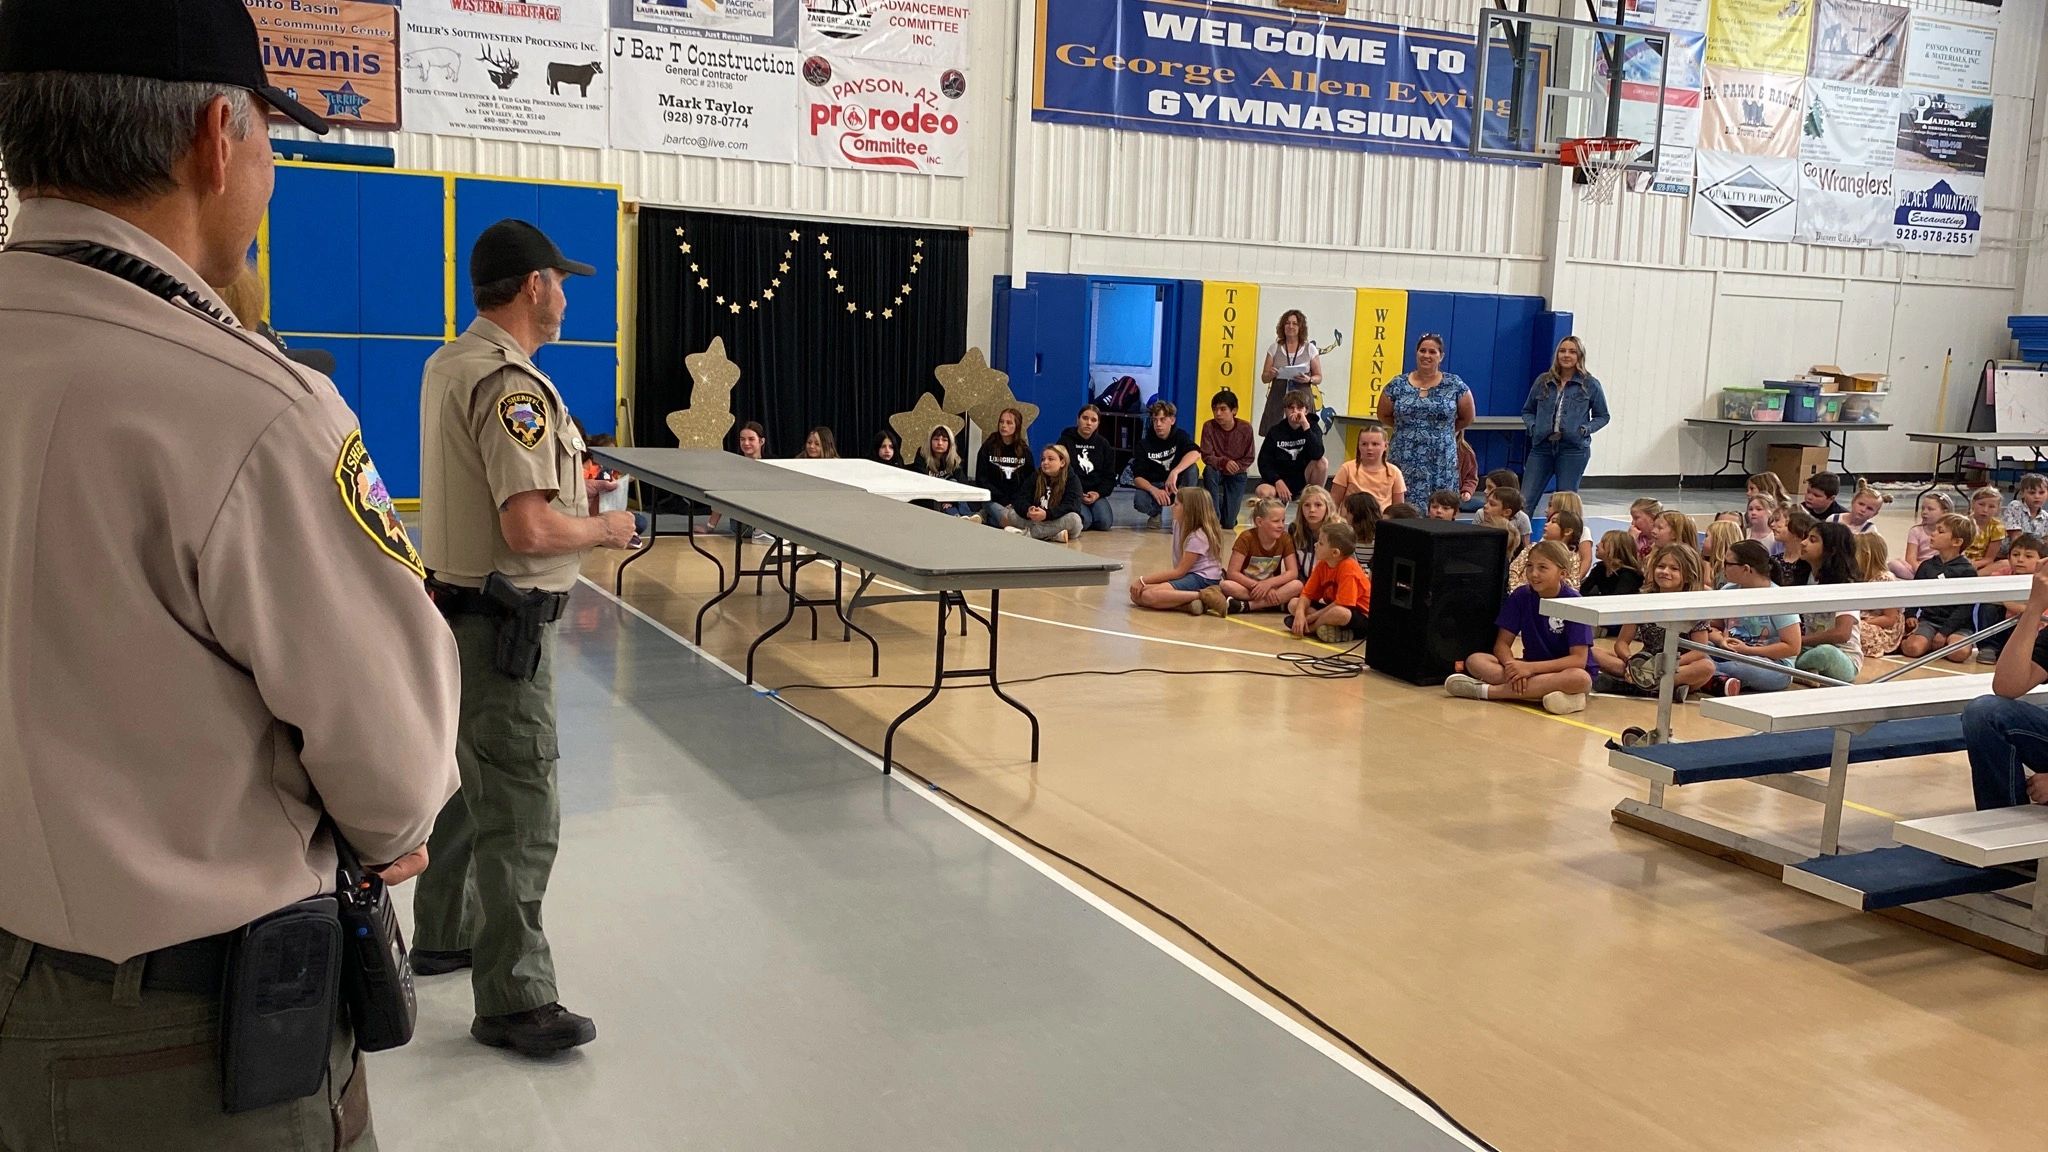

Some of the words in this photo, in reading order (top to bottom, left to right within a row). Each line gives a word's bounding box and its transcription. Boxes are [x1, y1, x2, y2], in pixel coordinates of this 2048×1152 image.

[245, 0, 283, 10] onto
[291, 0, 338, 15] Basin
[451, 0, 503, 14] WESTERN
[507, 2, 560, 20] HERITAGE
[725, 8, 767, 18] MORTGAGE
[880, 0, 969, 19] ADVANCEMENT
[260, 17, 268, 25] &
[274, 18, 346, 34] Community
[351, 25, 392, 37] Center
[807, 14, 825, 22] ZANE
[889, 16, 959, 34] COMMITTEE
[283, 35, 309, 45] Since
[406, 23, 449, 36] MILLER'S
[452, 28, 522, 44] SOUTHWESTERN
[525, 36, 578, 50] PROCESSING
[581, 41, 598, 52] INC.
[657, 25, 668, 33] No
[704, 30, 720, 39] Just
[722, 32, 753, 42] Results!
[912, 34, 936, 47] INC.
[1142, 10, 1387, 66] WELCOME
[1410, 44, 1467, 75] TO
[262, 37, 381, 75] iwanis
[613, 37, 625, 56] J
[631, 38, 664, 61] Bar
[670, 42, 682, 62] T
[687, 44, 795, 76] Construction
[1925, 43, 1948, 52] PAYSON
[1949, 46, 1982, 56] CONCRETE
[665, 64, 700, 77] General
[702, 67, 748, 82] Contractor
[1055, 43, 1236, 86] George
[1251, 66, 1371, 98] Allen
[680, 77, 699, 86] ROC
[700, 79, 705, 87] #
[832, 78, 909, 100] PAYSON,
[1723, 83, 1755, 98] FARM
[658, 93, 702, 109] Mark
[704, 98, 754, 116] Taylor
[663, 110, 693, 125] (928)
[696, 113, 749, 129] 978-0774
[1147, 88, 1453, 143] GYMNASIUM
[1914, 108, 1977, 128] LANDSCAPE
[662, 132, 748, 150] jbartco@live.com
[840, 132, 928, 160] Committee
[1803, 162, 1817, 178] Go
[1818, 168, 1892, 199] Wranglers!
[1708, 188, 1746, 201] QUALITY
[1748, 192, 1785, 205] PUMPING
[1900, 189, 1928, 208] BLACK
[1932, 192, 1979, 212] MOUNTAIN
[1910, 212, 1965, 229] Excavating
[1896, 228, 1974, 244] 928-978-2551
[1220, 289, 1237, 377] TONTO
[1369, 308, 1389, 416] WRANGL
[507, 395, 537, 405] SHERIFF
